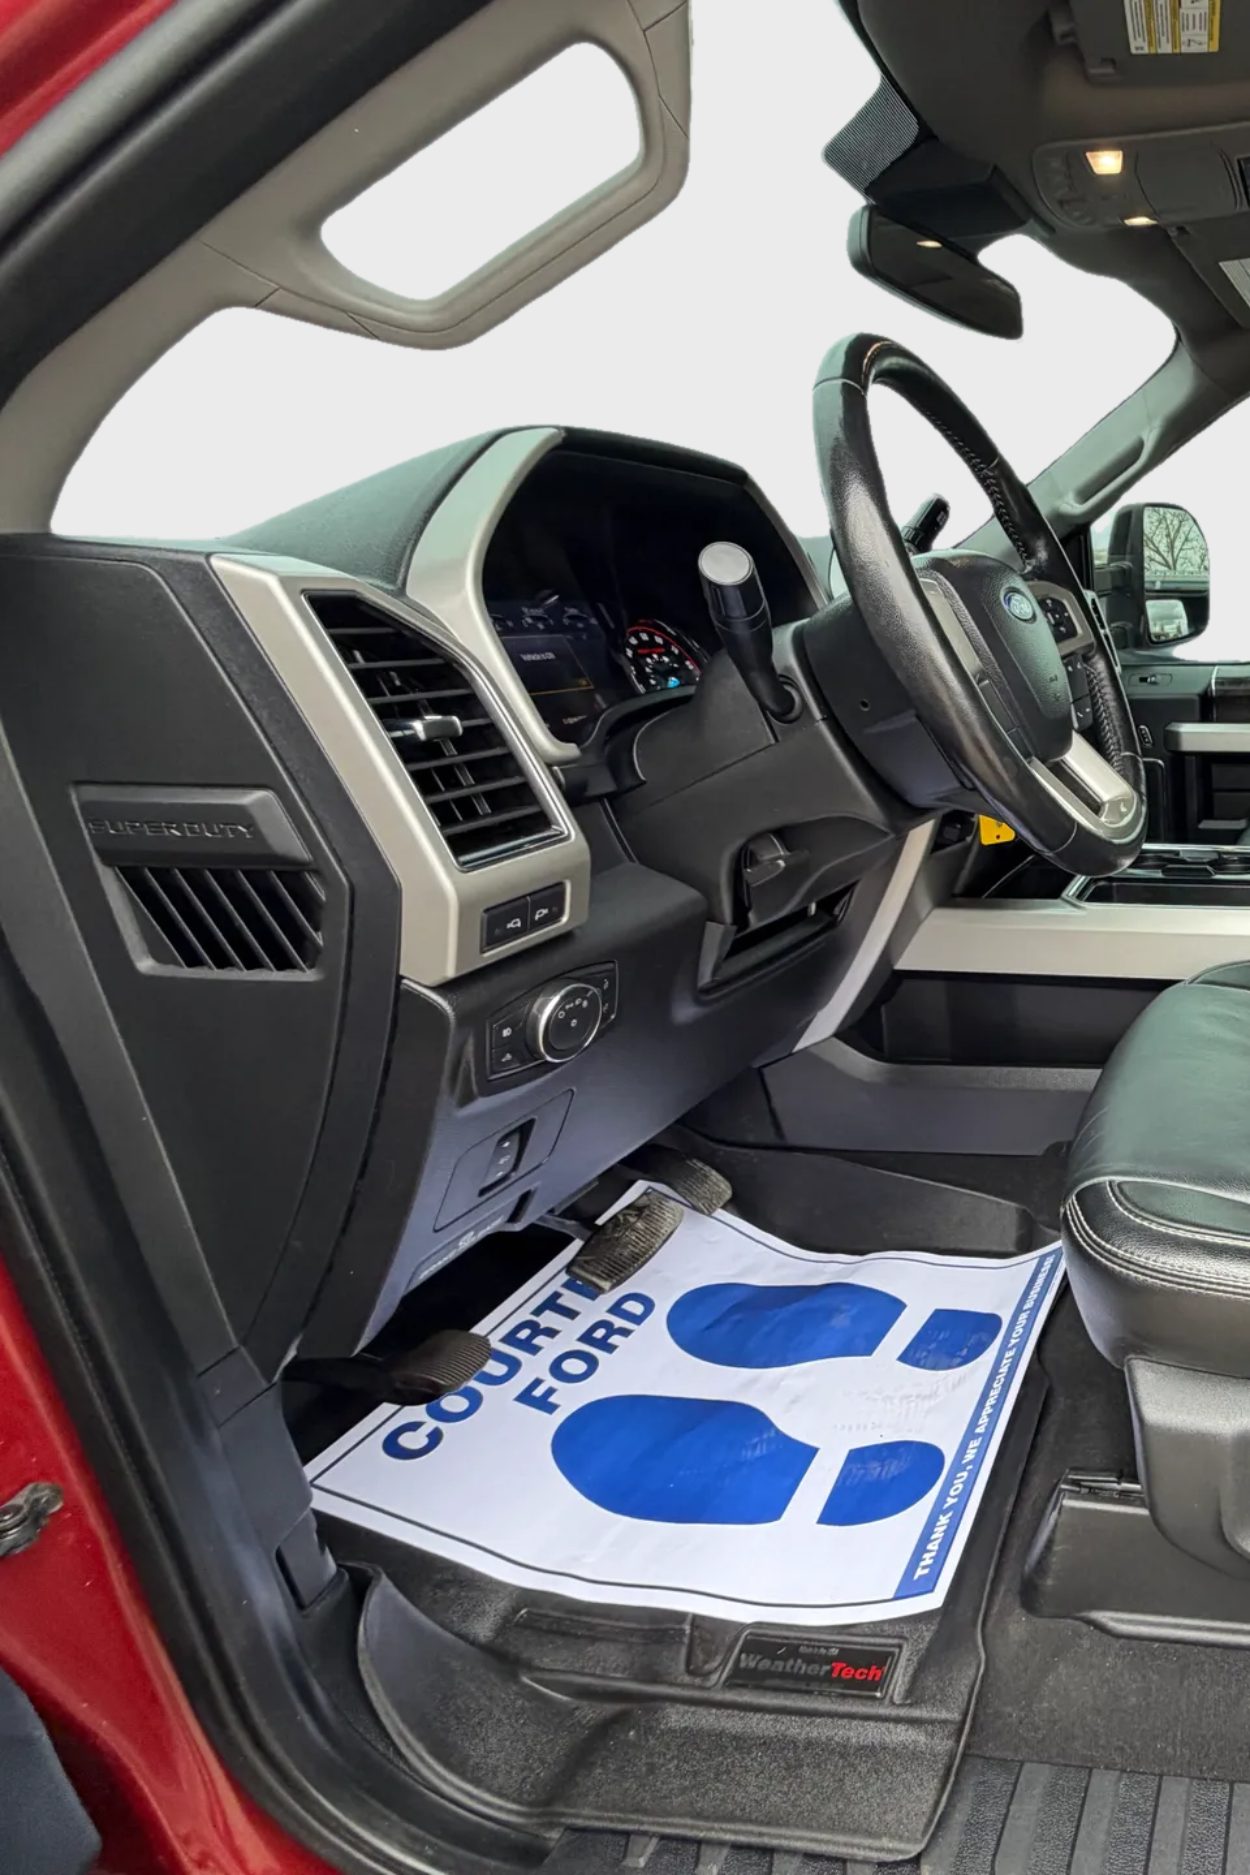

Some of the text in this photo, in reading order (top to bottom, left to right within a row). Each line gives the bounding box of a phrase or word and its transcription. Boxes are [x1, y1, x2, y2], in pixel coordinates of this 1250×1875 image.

[513, 1292, 655, 1415] FORD
[913, 1511, 953, 1581] THANK
[943, 1465, 973, 1510] YOU,
[962, 1437, 982, 1465] WE
[975, 1347, 1018, 1434] APPRECIATE
[1008, 1309, 1031, 1348] YOUR
[739, 1652, 883, 1681] WeatherTech
